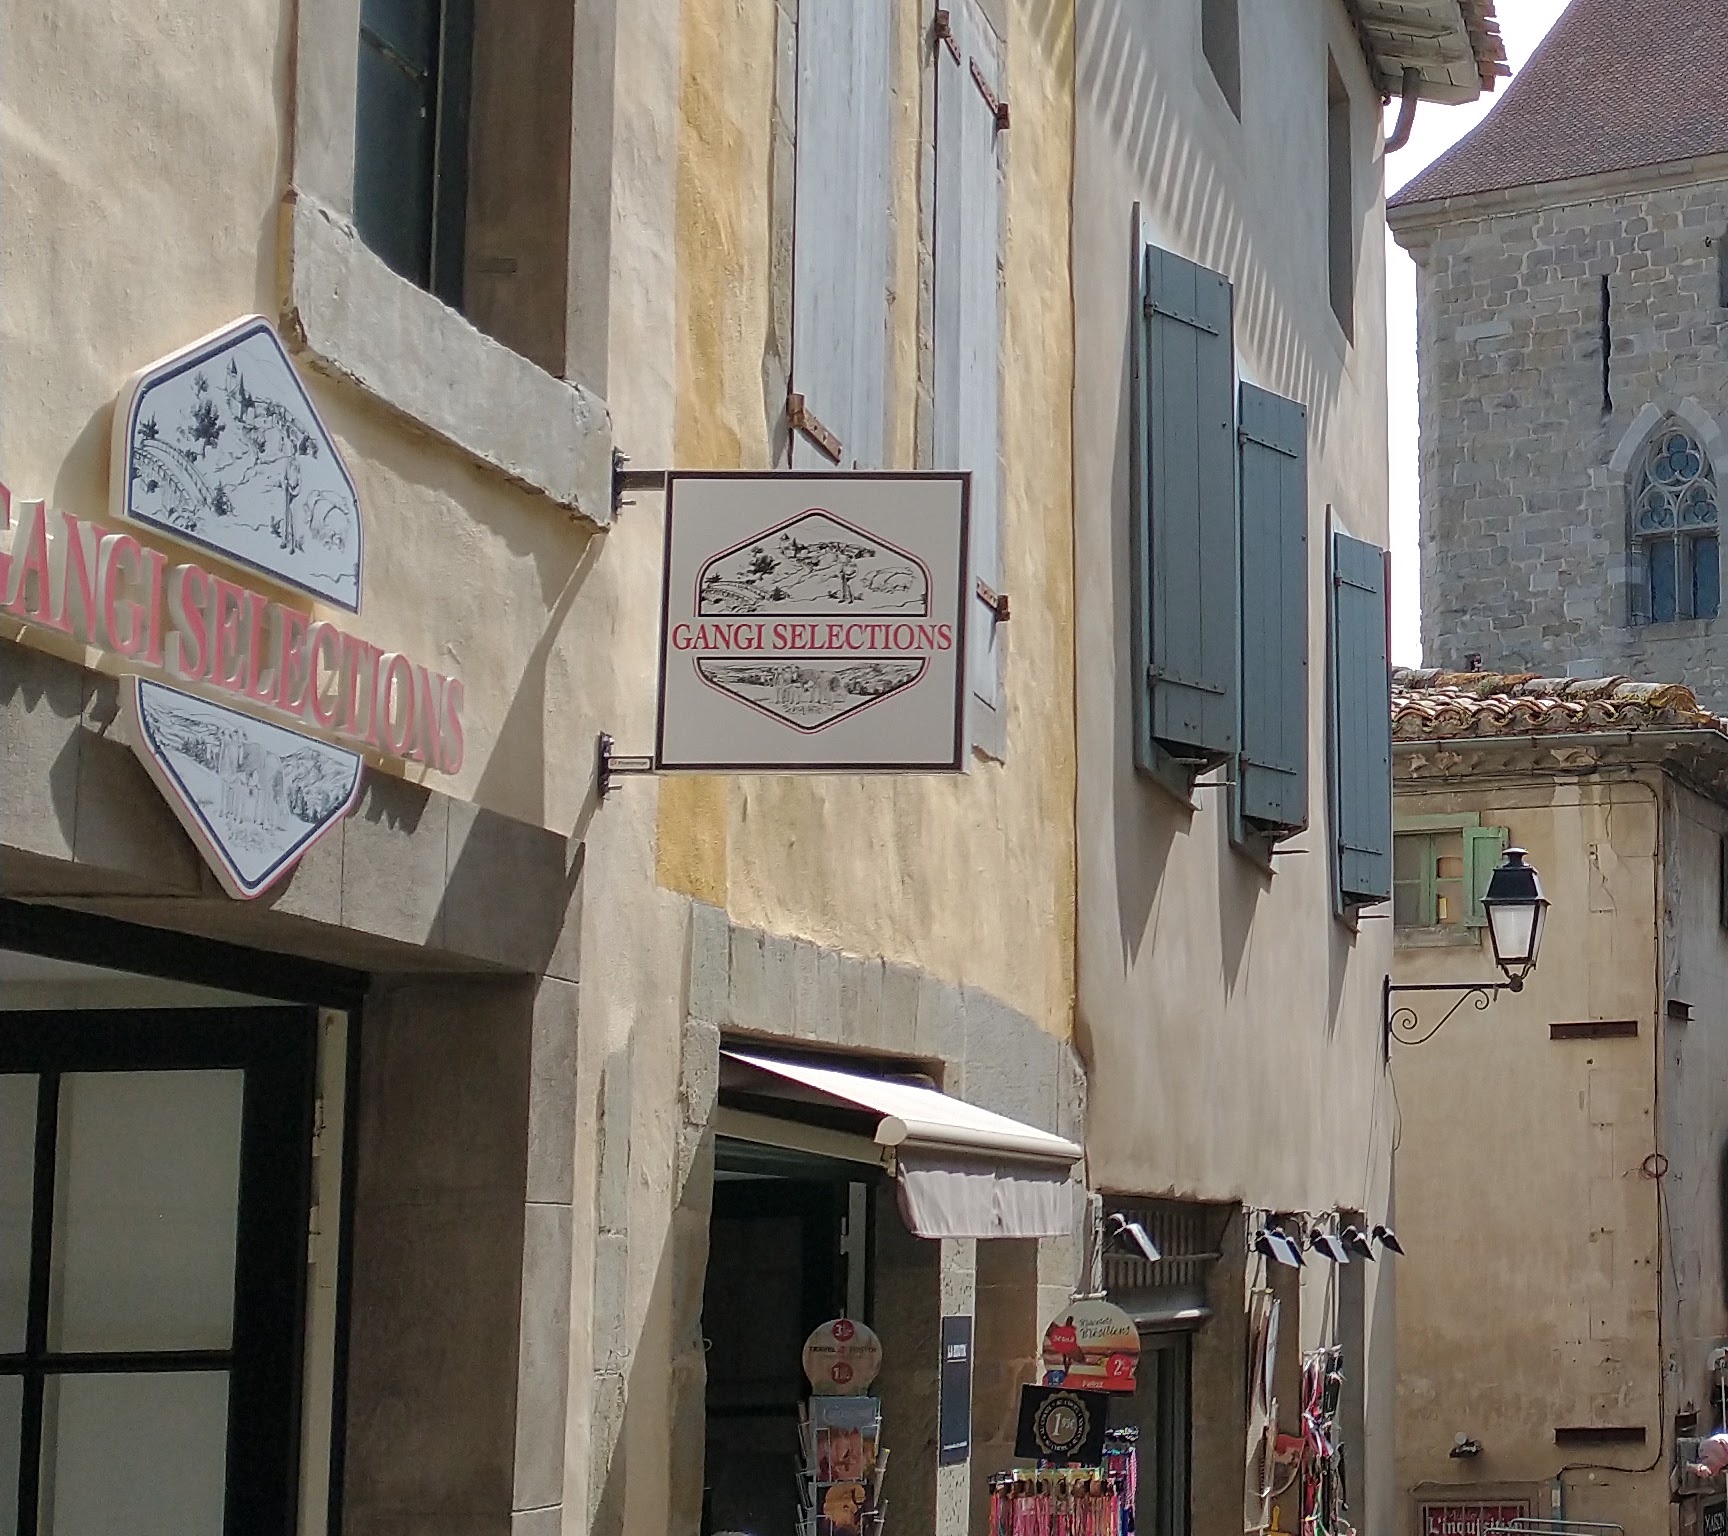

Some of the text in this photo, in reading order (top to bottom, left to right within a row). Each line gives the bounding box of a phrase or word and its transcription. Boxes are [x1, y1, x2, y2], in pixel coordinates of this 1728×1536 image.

[167, 564, 465, 776] SELECTIONS
[671, 622, 953, 652] GANGI SELECTIONS
